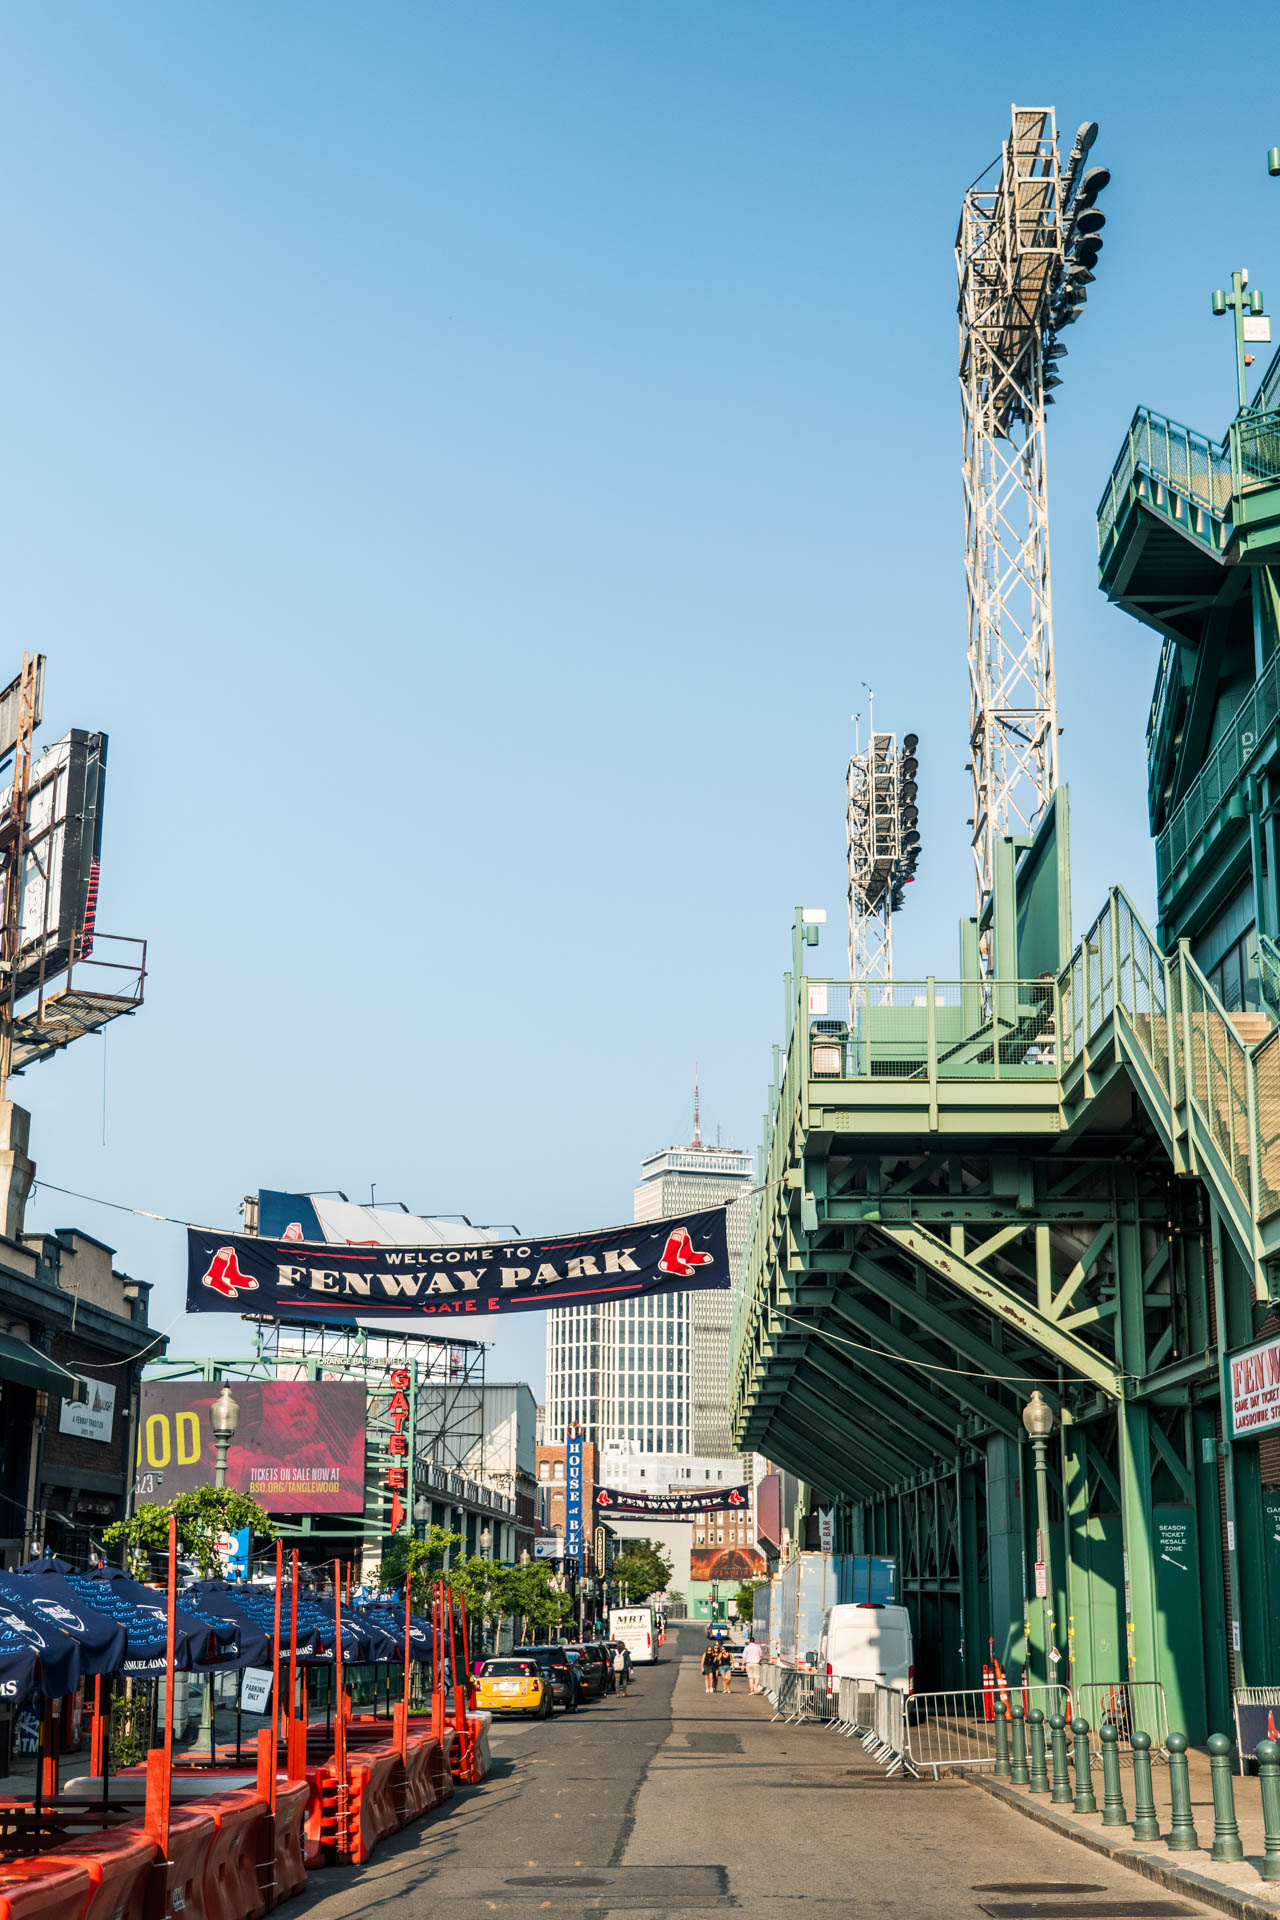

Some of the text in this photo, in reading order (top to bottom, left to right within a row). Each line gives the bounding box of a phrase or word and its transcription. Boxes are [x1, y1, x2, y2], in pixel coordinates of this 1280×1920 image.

[385, 1246, 531, 1265] WELCOME TO
[276, 1247, 641, 1296] FENWAY PARK
[423, 1297, 500, 1313] GATE E
[317, 1357, 412, 1365] ORANGE BARREL MEDIA
[1234, 1397, 1249, 1413] GAME
[1250, 1394, 1260, 1409] DAY
[1235, 1408, 1269, 1430] LANSDOWNE
[387, 1369, 411, 1488] GATE E
[137, 1411, 202, 1468] OD
[251, 1467, 340, 1481] TICKETS ON SALE NOW AT
[568, 1443, 580, 1502] HOUSE
[249, 1481, 340, 1494] BSO.ORG/TANGLEWOOD
[617, 1496, 724, 1509] FENWAY PARK
[616, 1615, 645, 1624] MBT
[246, 1684, 265, 1694] PARKING
